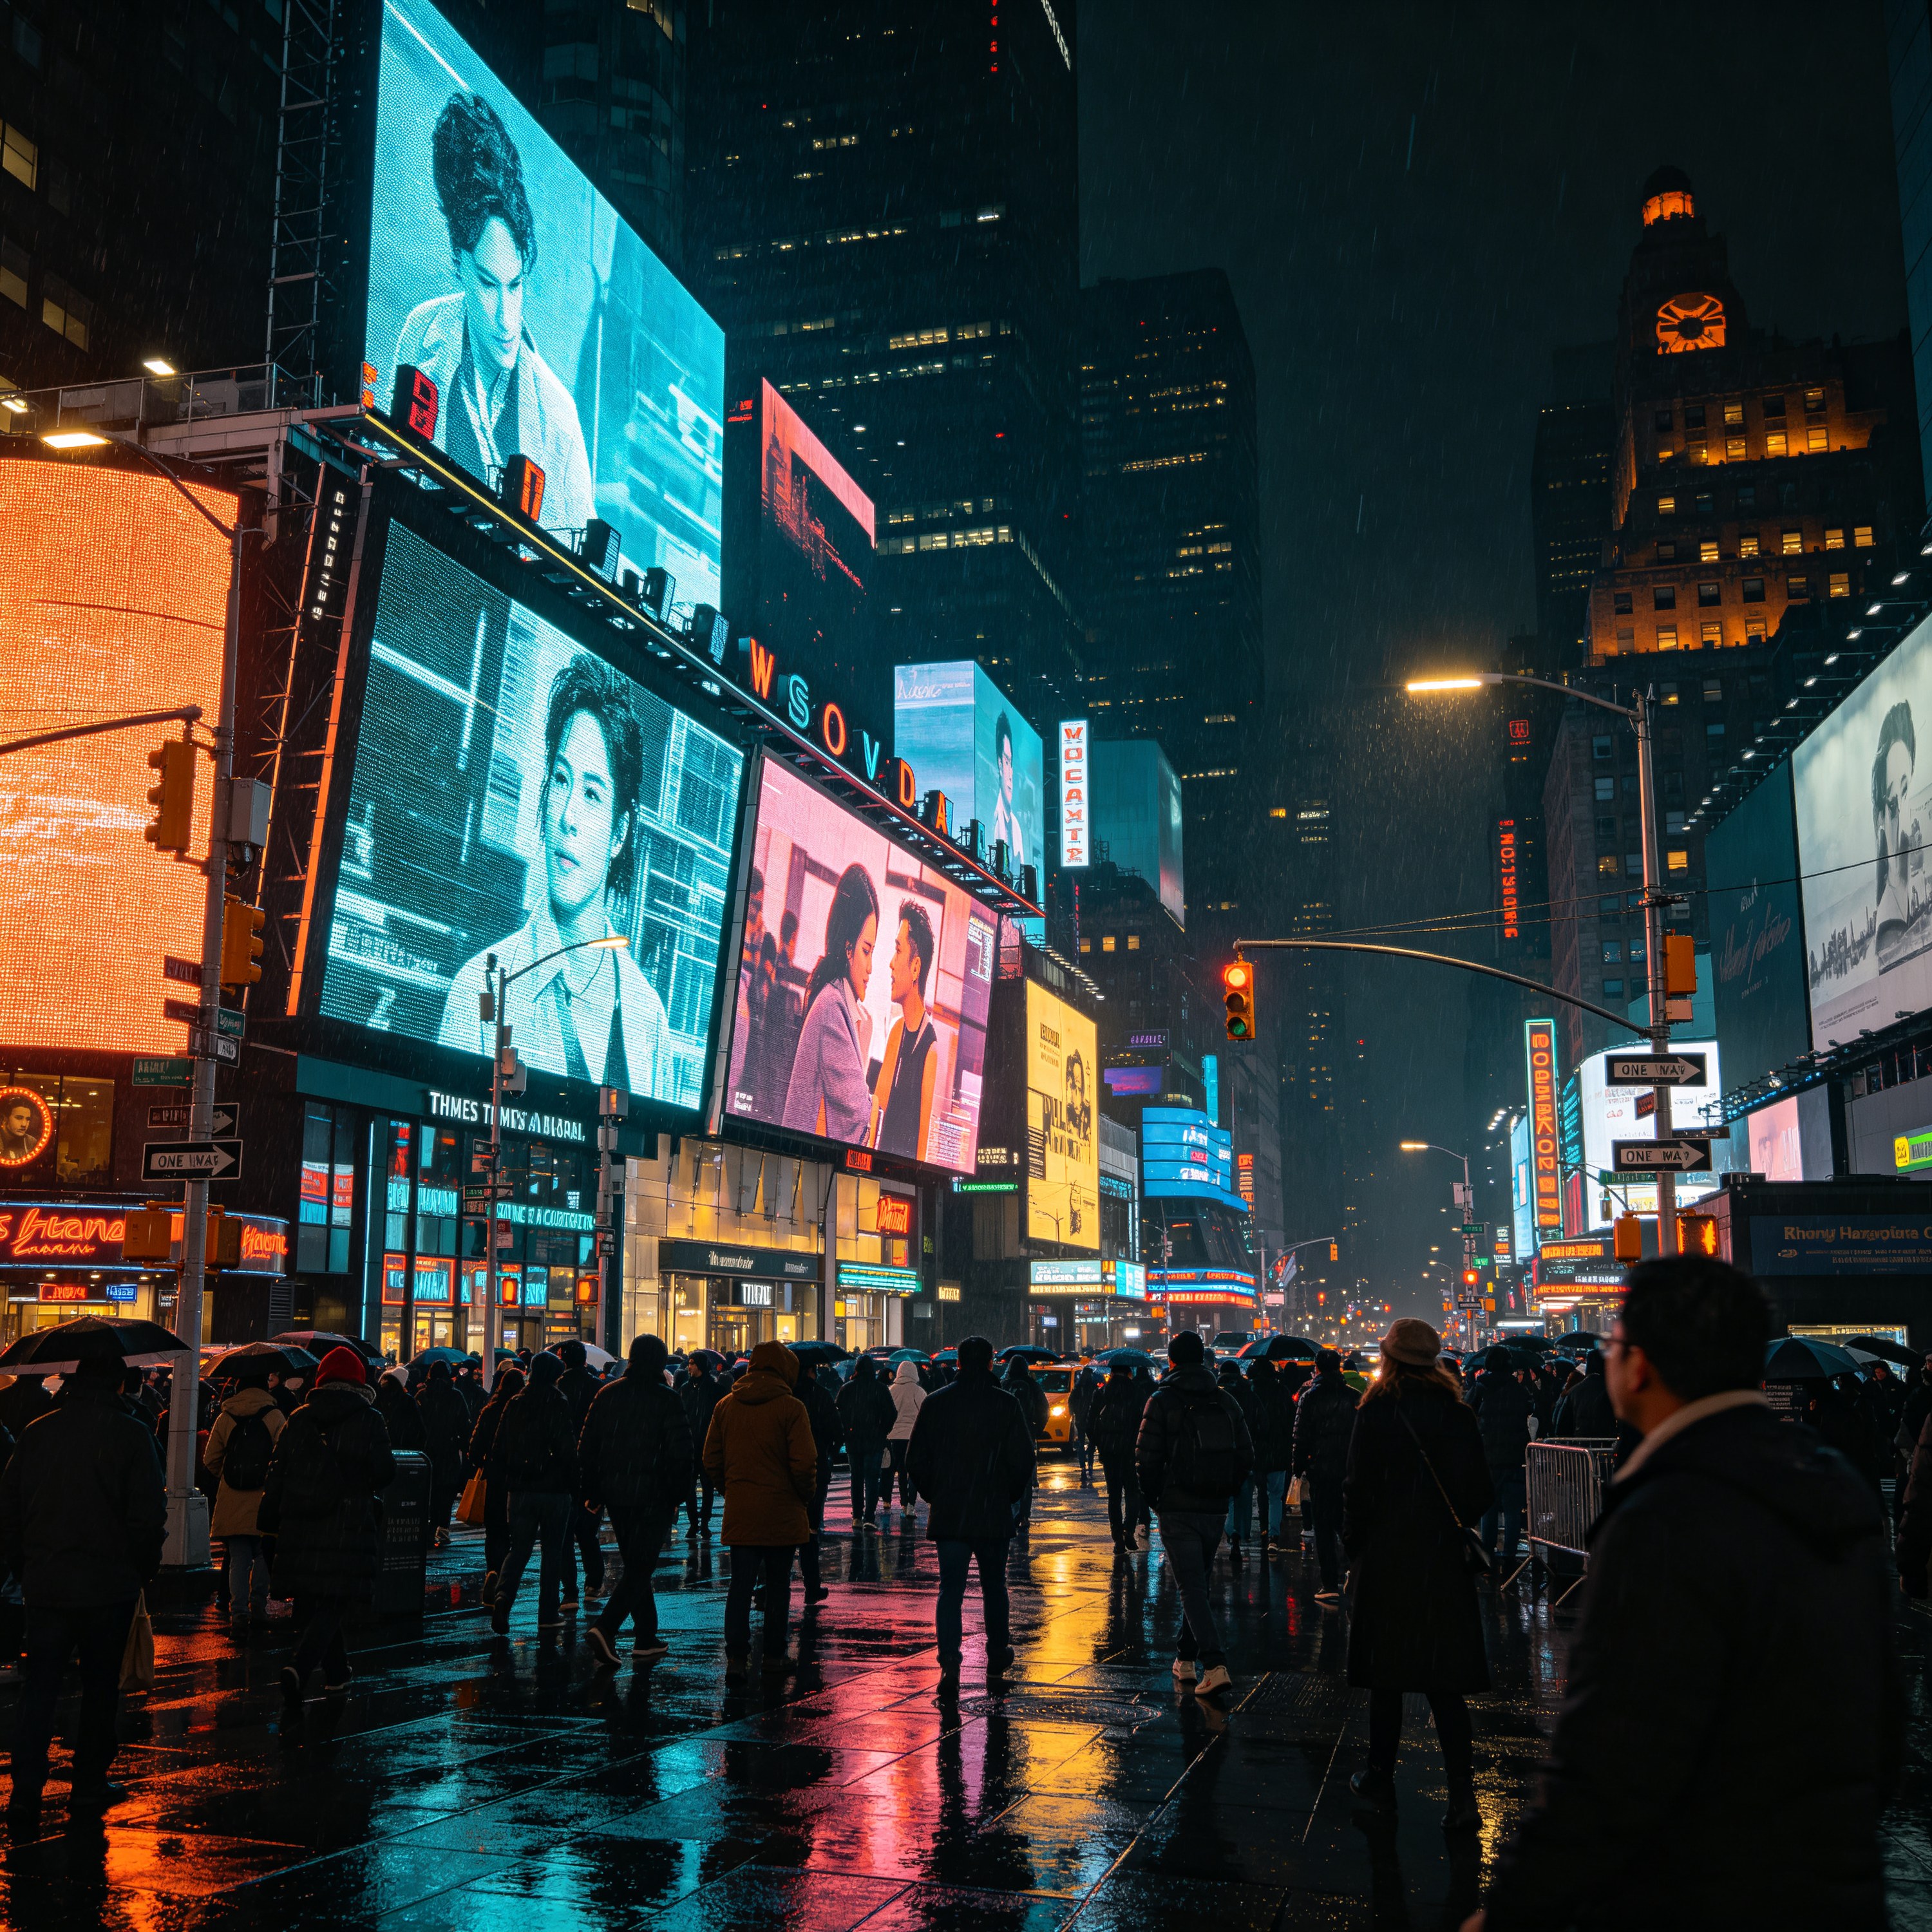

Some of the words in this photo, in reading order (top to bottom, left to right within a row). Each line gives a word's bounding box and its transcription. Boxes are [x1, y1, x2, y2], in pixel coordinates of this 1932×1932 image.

[1622, 1064, 1647, 1076] ONE
[158, 1155, 184, 1168] ONE
[1626, 1150, 1653, 1162] ONE
